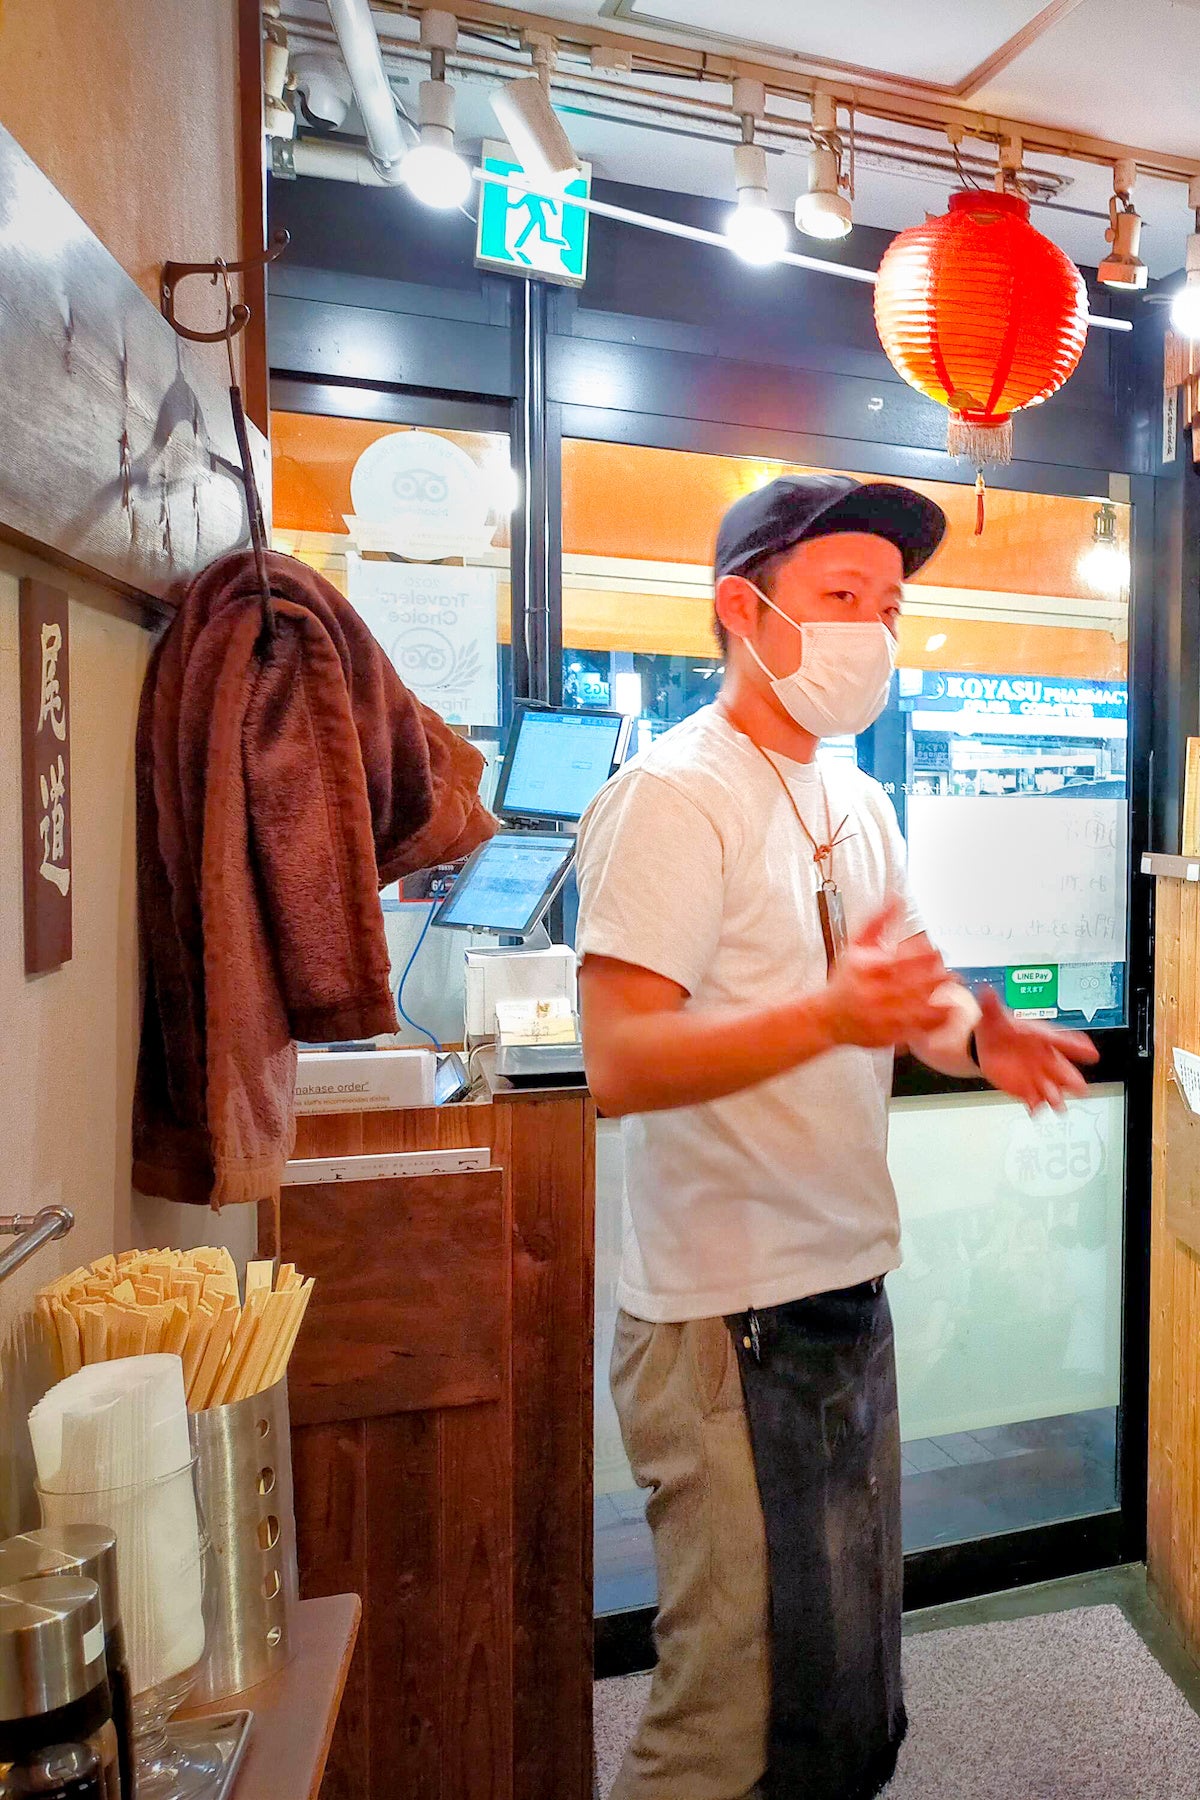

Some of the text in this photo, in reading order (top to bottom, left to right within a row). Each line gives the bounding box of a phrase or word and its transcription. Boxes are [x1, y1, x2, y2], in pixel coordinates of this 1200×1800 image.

[947, 677, 1044, 702] KOYASU
[37, 621, 71, 898] 尾道
[1016, 972, 1049, 981] LINE Pay
